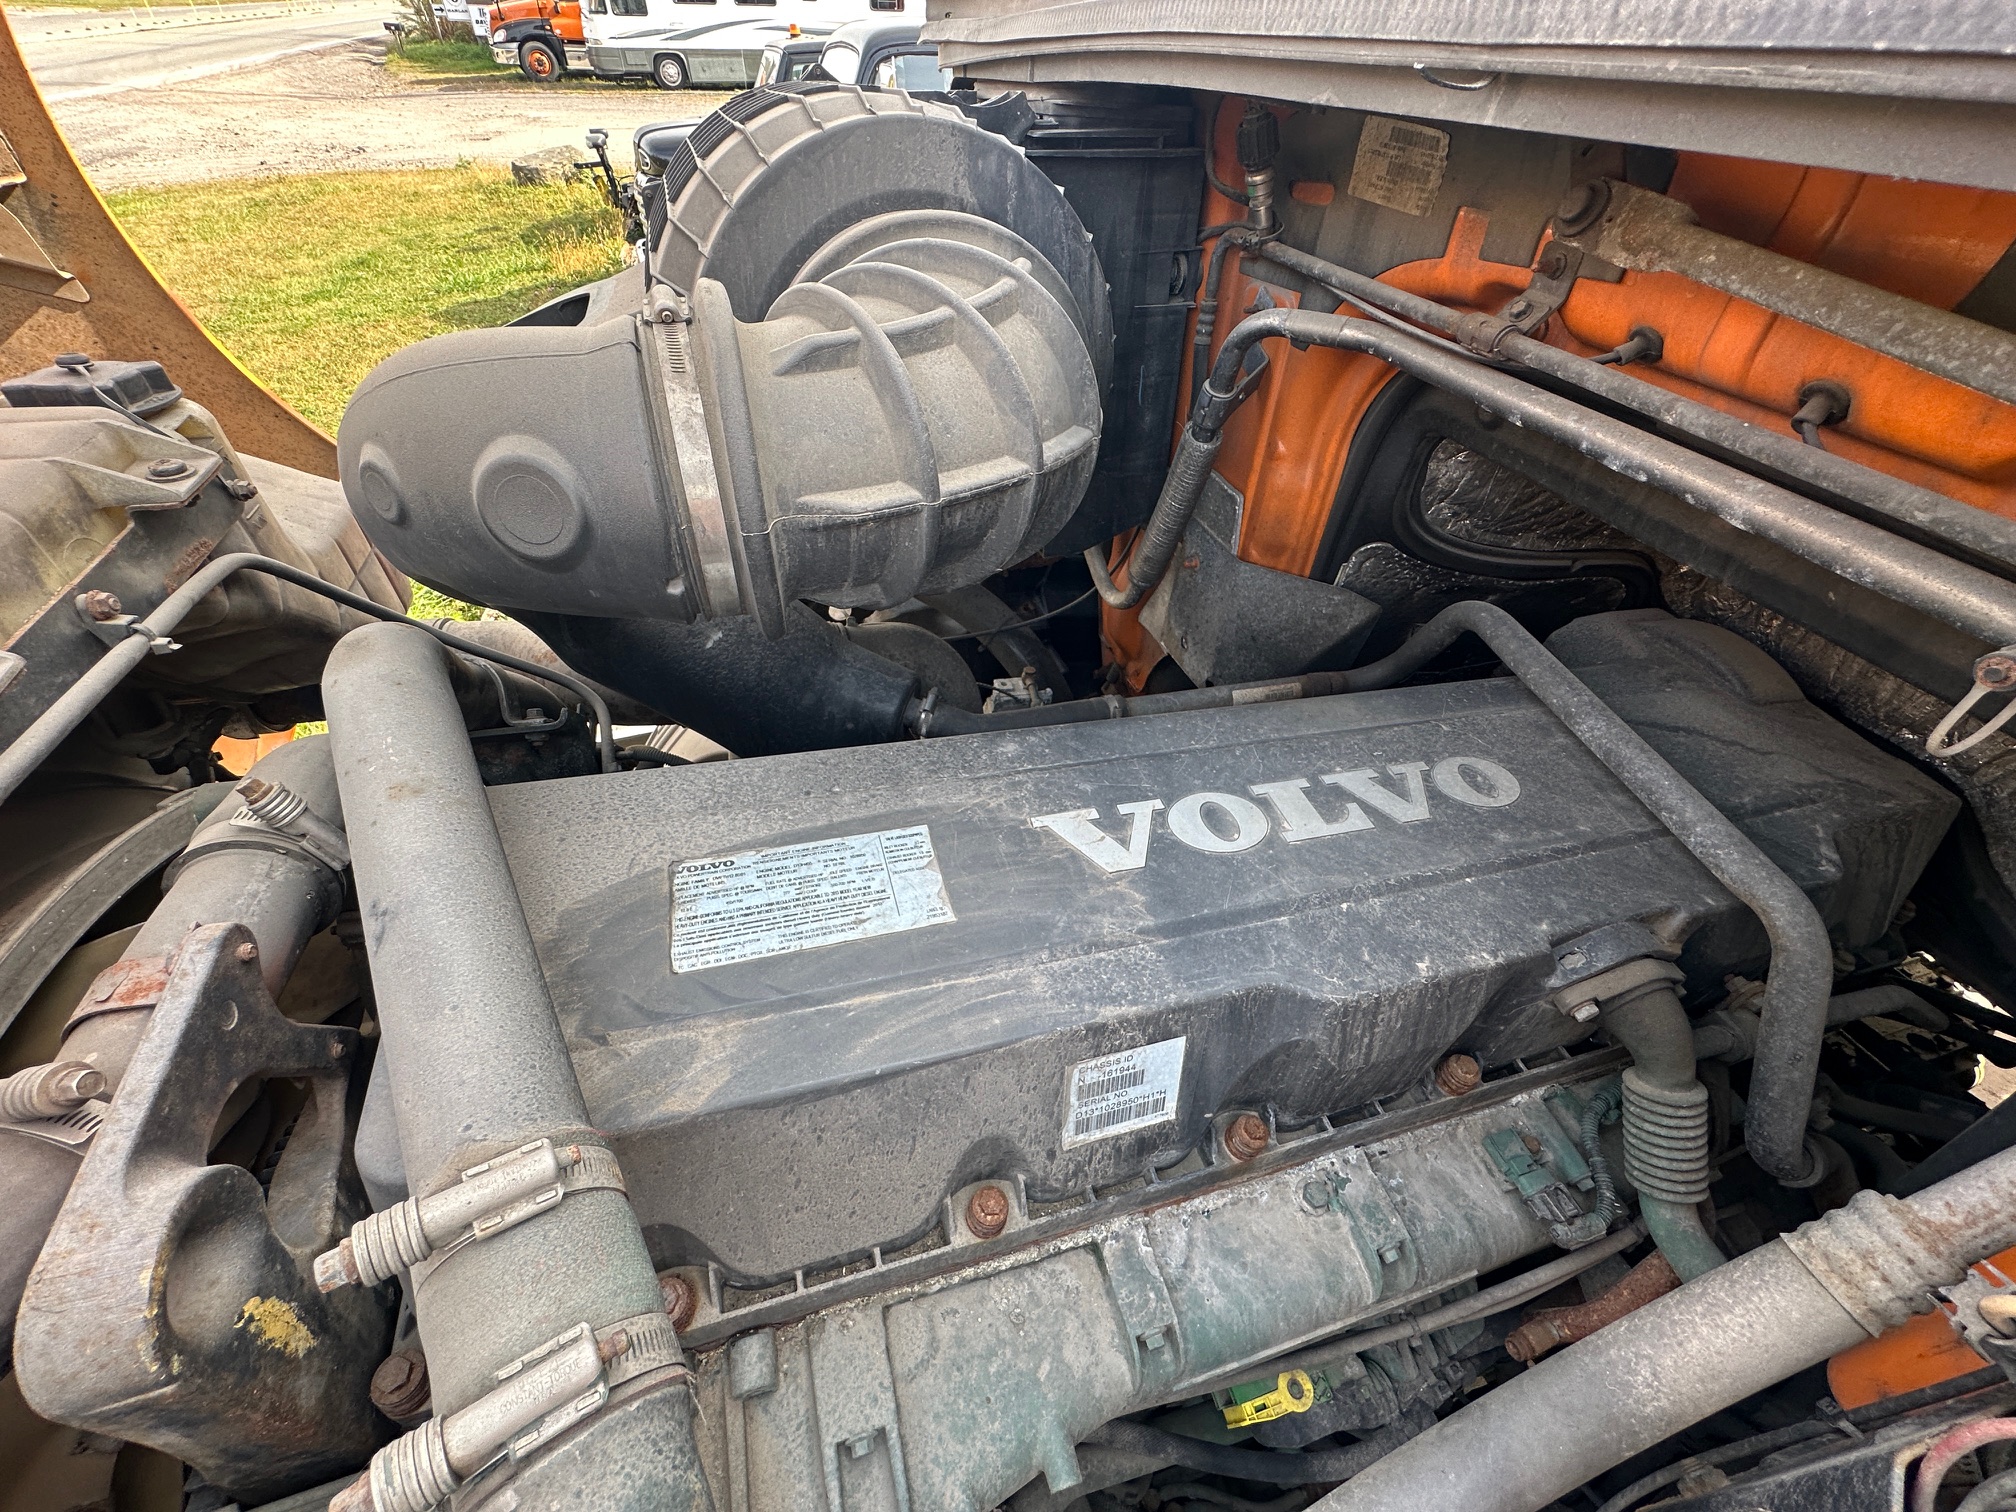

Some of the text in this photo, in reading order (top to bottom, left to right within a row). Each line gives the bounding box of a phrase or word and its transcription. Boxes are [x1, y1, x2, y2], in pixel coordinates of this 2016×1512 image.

[1031, 756, 1521, 873] VOLVO
[676, 859, 735, 874] VOLVO
[1079, 1057, 1121, 1074] CHASSIS
[1078, 1090, 1128, 1109] SERIAL NO
